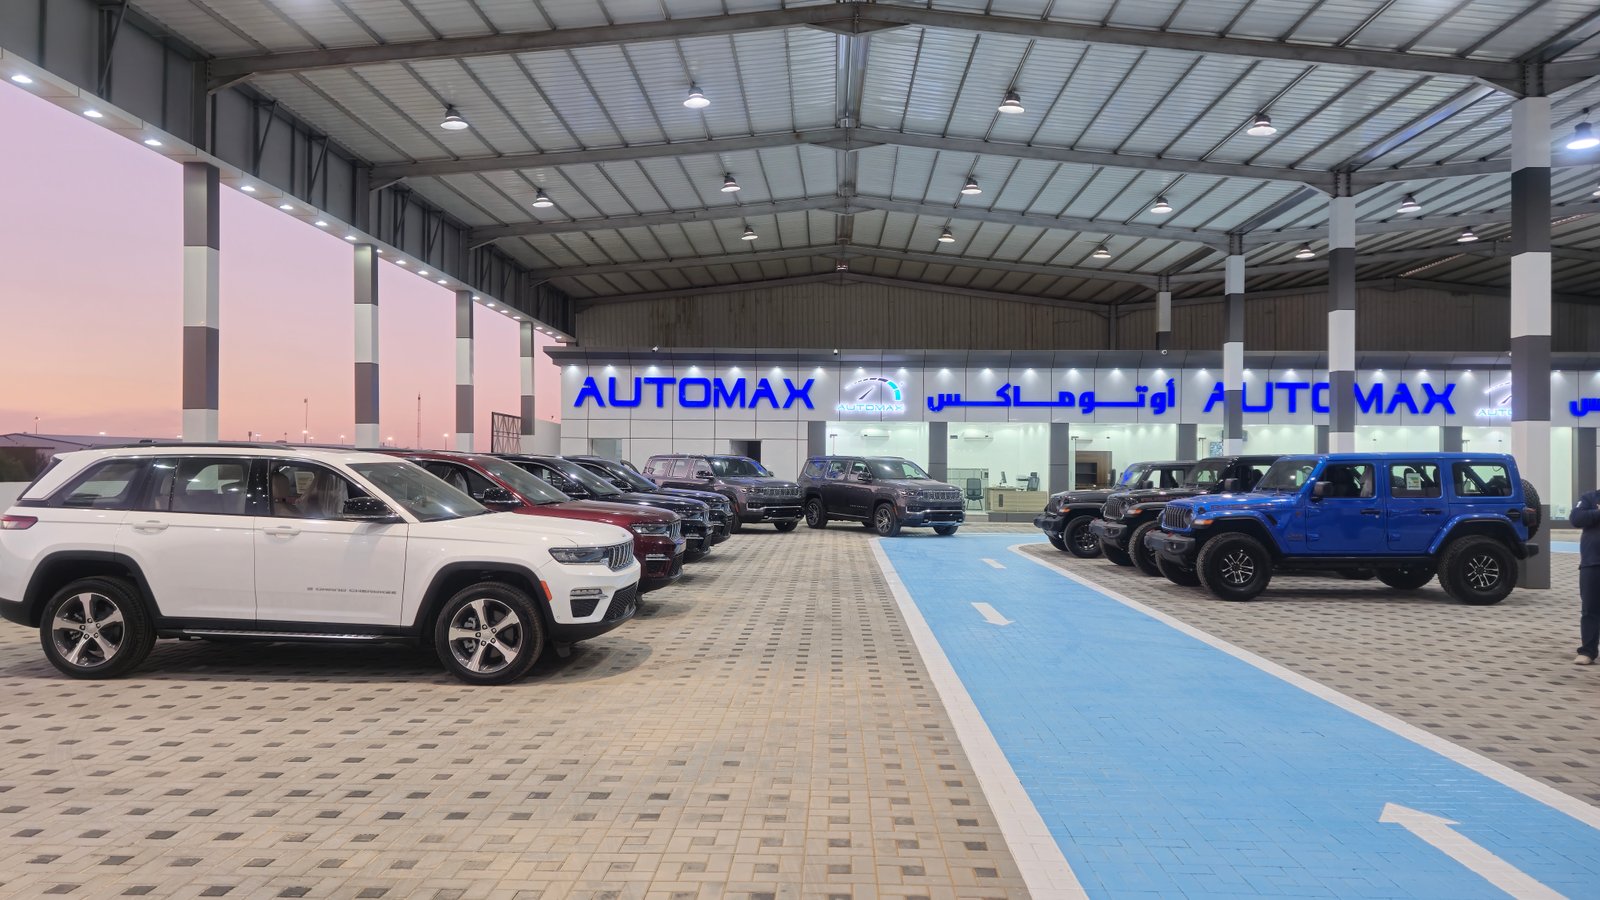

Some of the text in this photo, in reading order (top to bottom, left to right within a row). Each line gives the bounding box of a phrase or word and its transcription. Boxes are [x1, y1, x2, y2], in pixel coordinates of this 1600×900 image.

[573, 375, 814, 410] AUTOMAX
[837, 403, 905, 412] AUTOMAX
[926, 377, 1175, 415] أوتوماكس
